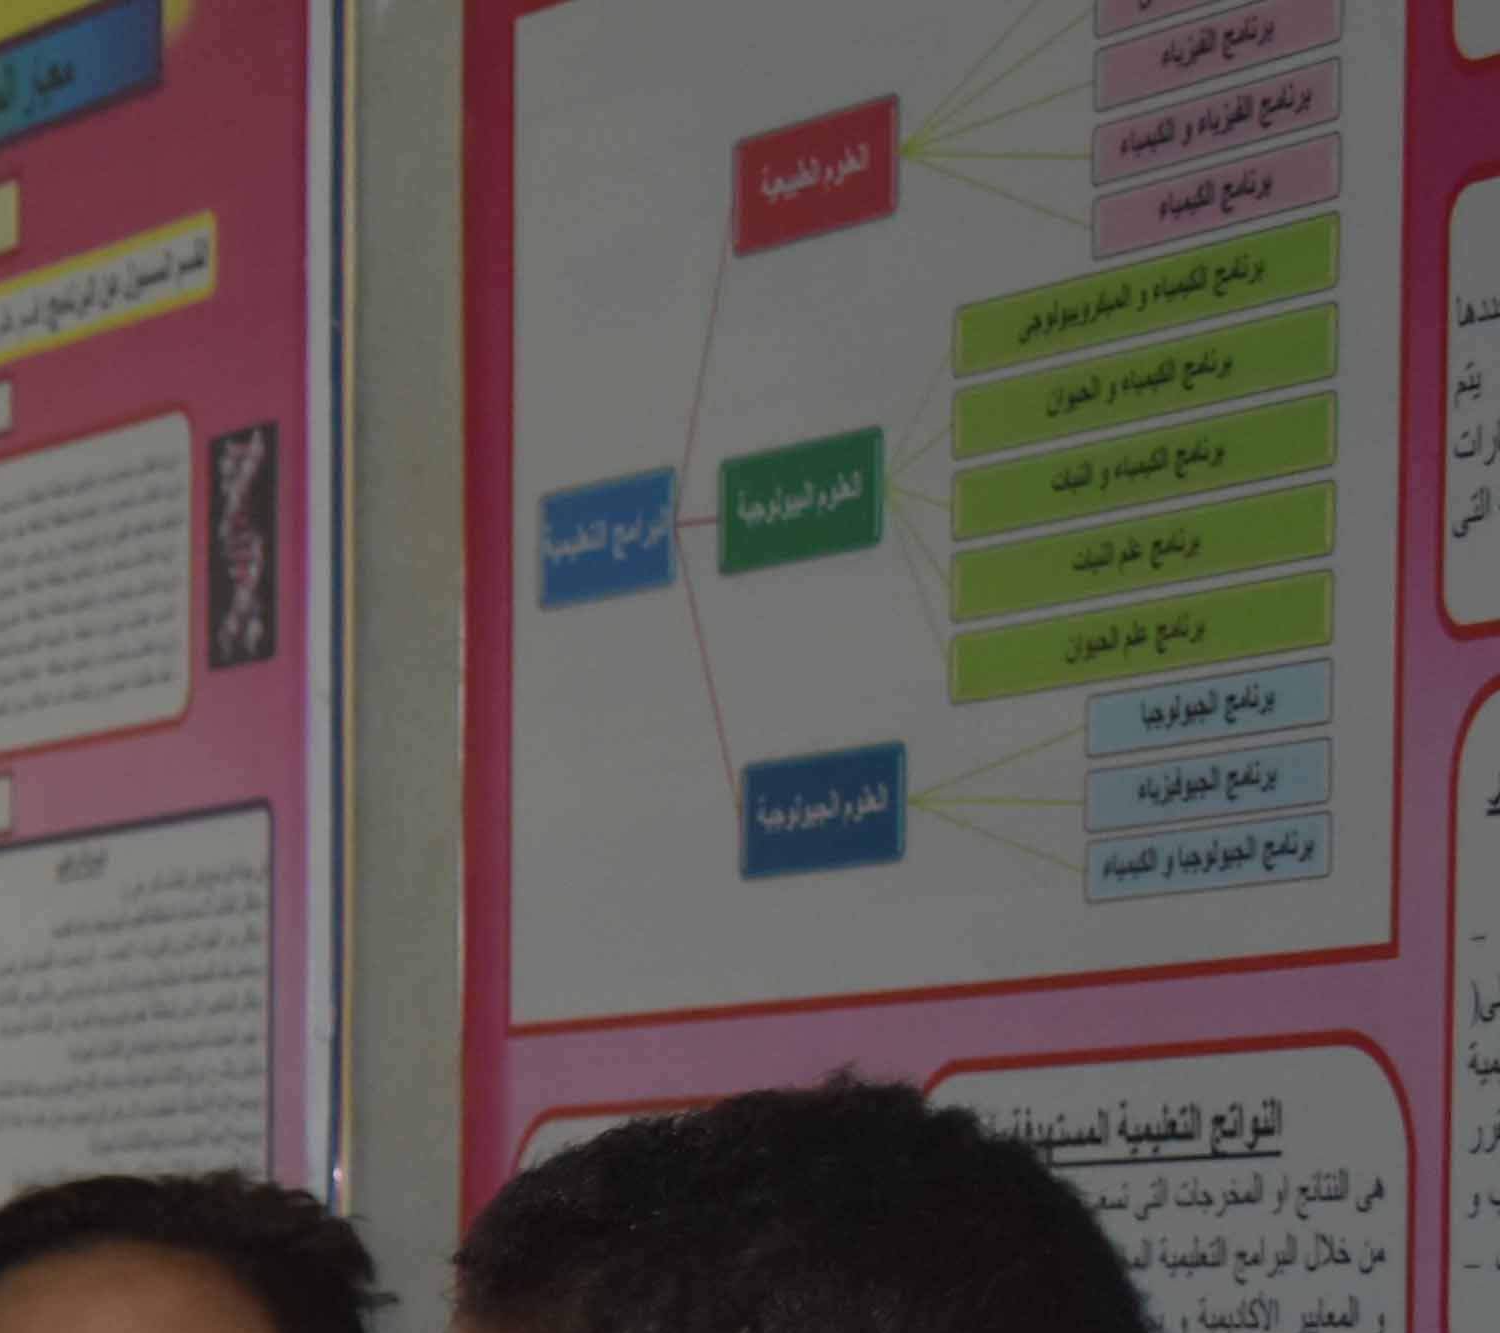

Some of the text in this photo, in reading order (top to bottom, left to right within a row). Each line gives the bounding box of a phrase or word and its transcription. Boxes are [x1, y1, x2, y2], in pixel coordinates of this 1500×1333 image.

[1161, 16, 1275, 68] برنامج الفيزياء
[1119, 83, 1312, 157] برنامج الفيزياء و الكيمياء
[759, 143, 869, 206] العلوم الطبيعية
[1158, 170, 1272, 222] برنامج الكيمياء
[1136, 288, 1148, 312] و
[1152, 265, 1208, 301] الكيمياء
[1212, 253, 1266, 298] برنامج
[1045, 348, 1234, 417] برنامج الكيمياء و الحيوان
[1049, 434, 1227, 495] برنامج الكيمياء و النبات
[737, 469, 863, 527] العلوم البيولوجية
[1070, 528, 1202, 577] برنامج علم النبات
[1064, 614, 1206, 664] برنامج علم الحيوان
[1140, 683, 1275, 733] برنامج الجيولوجيا
[757, 782, 888, 832] العلوم الجيولوجية
[1136, 761, 1277, 806] برنامج الجيوفيزياء
[1102, 830, 1315, 882] برنامج الجيولوجيا و الكيمياء
[1118, 1099, 1201, 1157] التعليمية
[1210, 1098, 1282, 1157] النواتج
[1175, 1170, 1264, 1217] المخرجات
[1294, 1167, 1349, 1219] النتائج
[1159, 1236, 1226, 1278] التعليمية
[1232, 1232, 1297, 1285] البرامج
[1308, 1231, 1351, 1272] خلال
[1357, 1238, 1386, 1274] من
